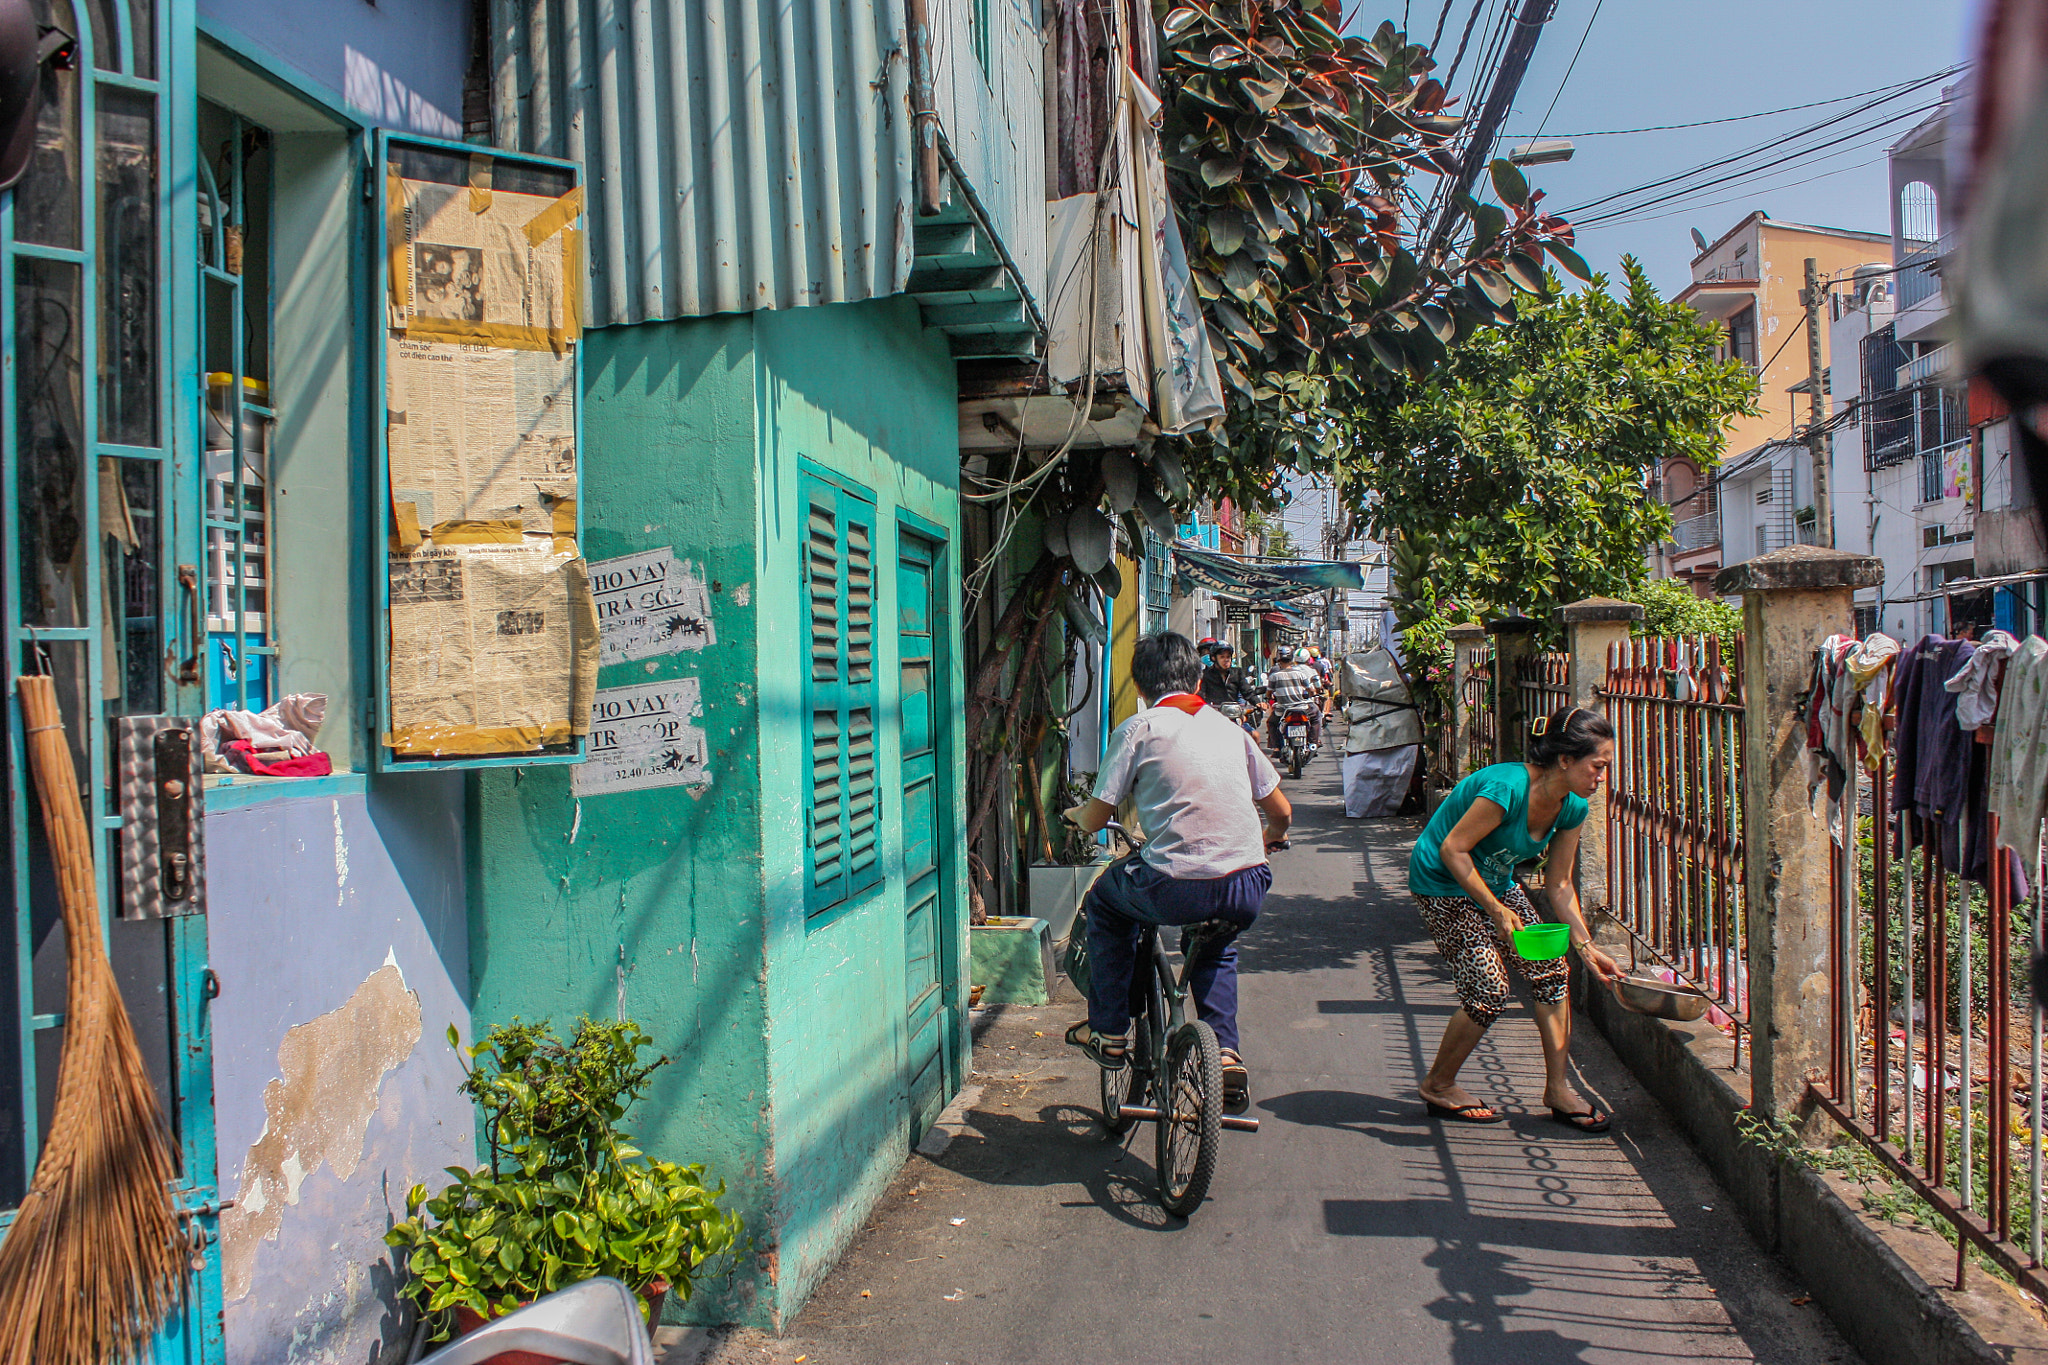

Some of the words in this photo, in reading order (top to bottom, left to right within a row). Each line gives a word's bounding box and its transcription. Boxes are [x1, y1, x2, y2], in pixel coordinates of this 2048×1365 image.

[593, 572, 623, 591] HO
[628, 560, 669, 583] VAY
[626, 693, 669, 714] VAY
